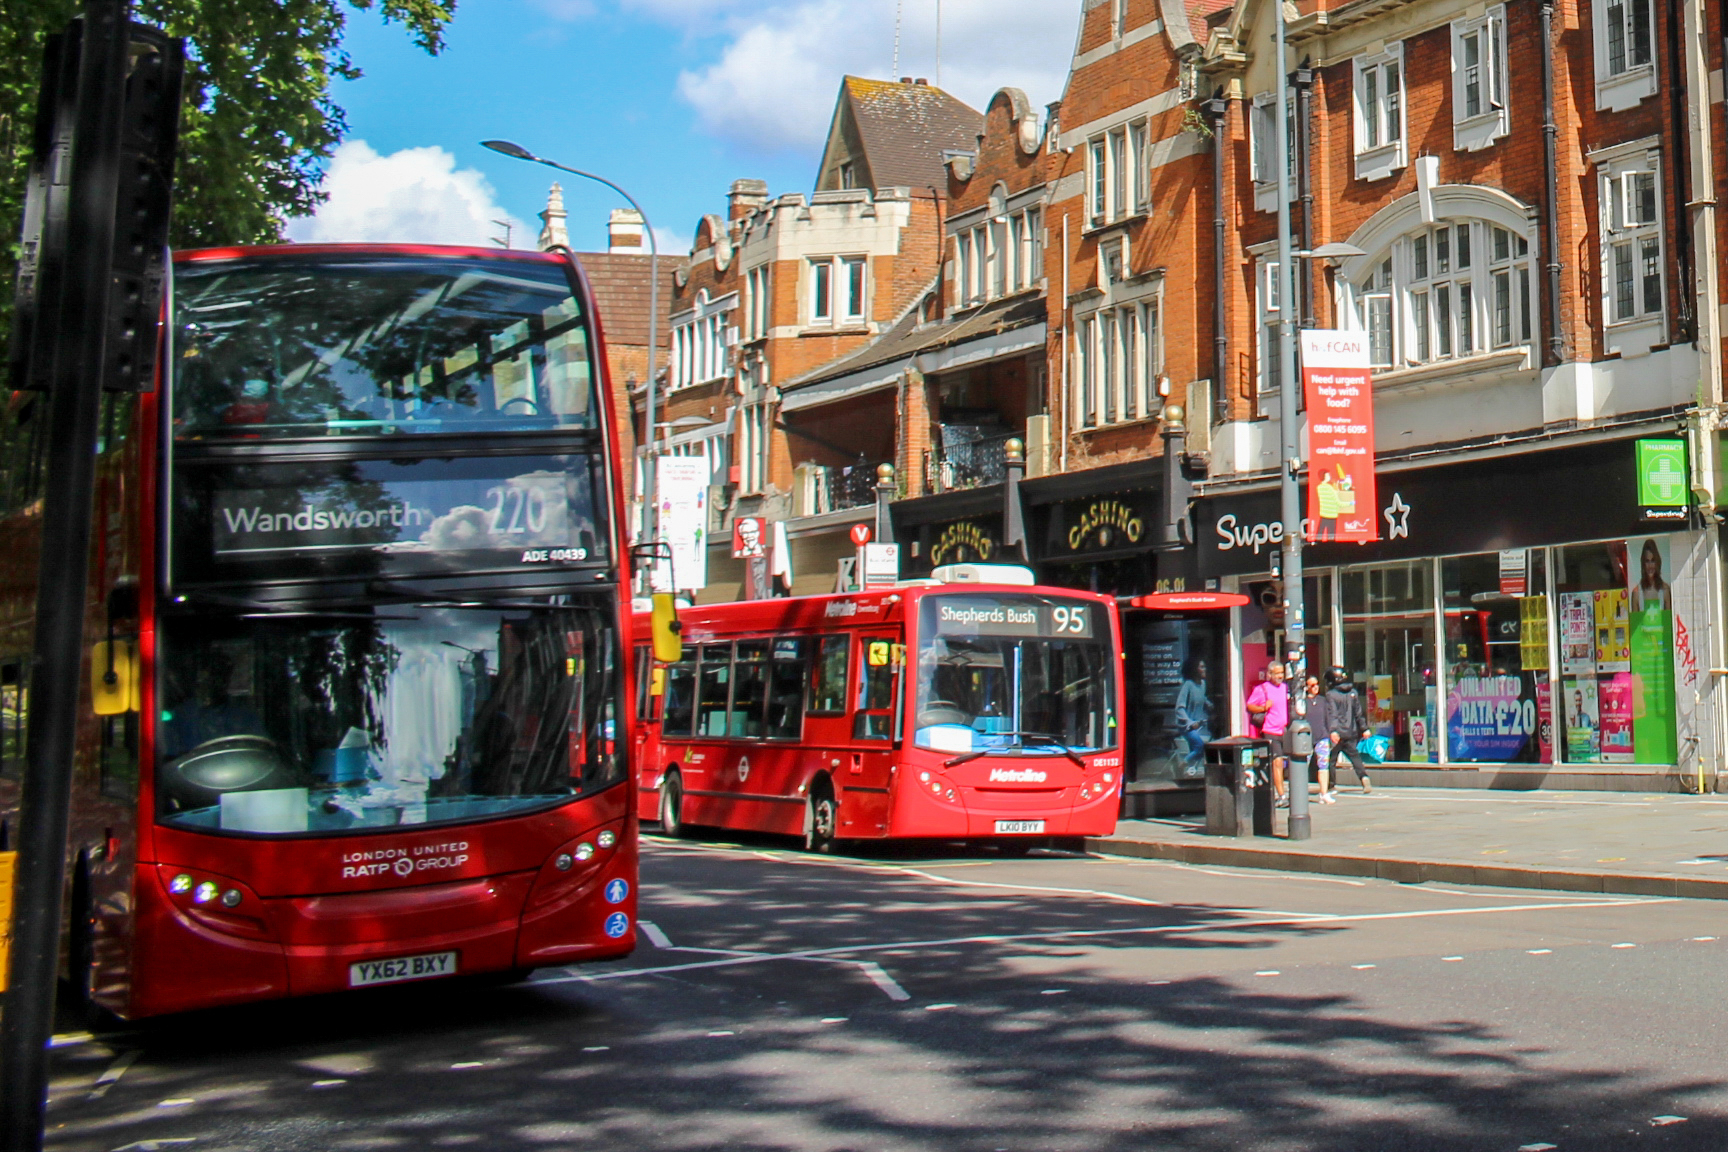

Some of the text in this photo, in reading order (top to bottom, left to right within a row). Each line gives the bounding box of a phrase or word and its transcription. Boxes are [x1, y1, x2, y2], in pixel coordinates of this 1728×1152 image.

[1311, 375, 1365, 387] Need urgent
[1318, 386, 1359, 397] help with
[1326, 397, 1350, 408] food?
[1314, 425, 1367, 434] 0800 145 6095
[223, 502, 421, 533] Wandsworth
[486, 485, 547, 535] 220
[1646, 509, 1685, 519] Superdrug
[854, 527, 869, 542] V
[522, 548, 587, 563] ADE 40439
[824, 599, 857, 617] Metroline
[941, 606, 1036, 625] Shepherds Bush
[1053, 606, 1085, 633] 95
[1460, 676, 1522, 697] UNLIMITED
[1461, 700, 1494, 724] DATA
[1496, 699, 1536, 735] £20
[1481, 727, 1494, 735] TEXTS
[1093, 758, 1119, 766] DE1132
[989, 769, 1046, 782] Metroline
[1000, 821, 1038, 831] LK10 BYY
[343, 842, 469, 863] LONDON UNITED
[343, 855, 469, 878] RATP GROUP
[358, 955, 448, 981] YX62 BXY
